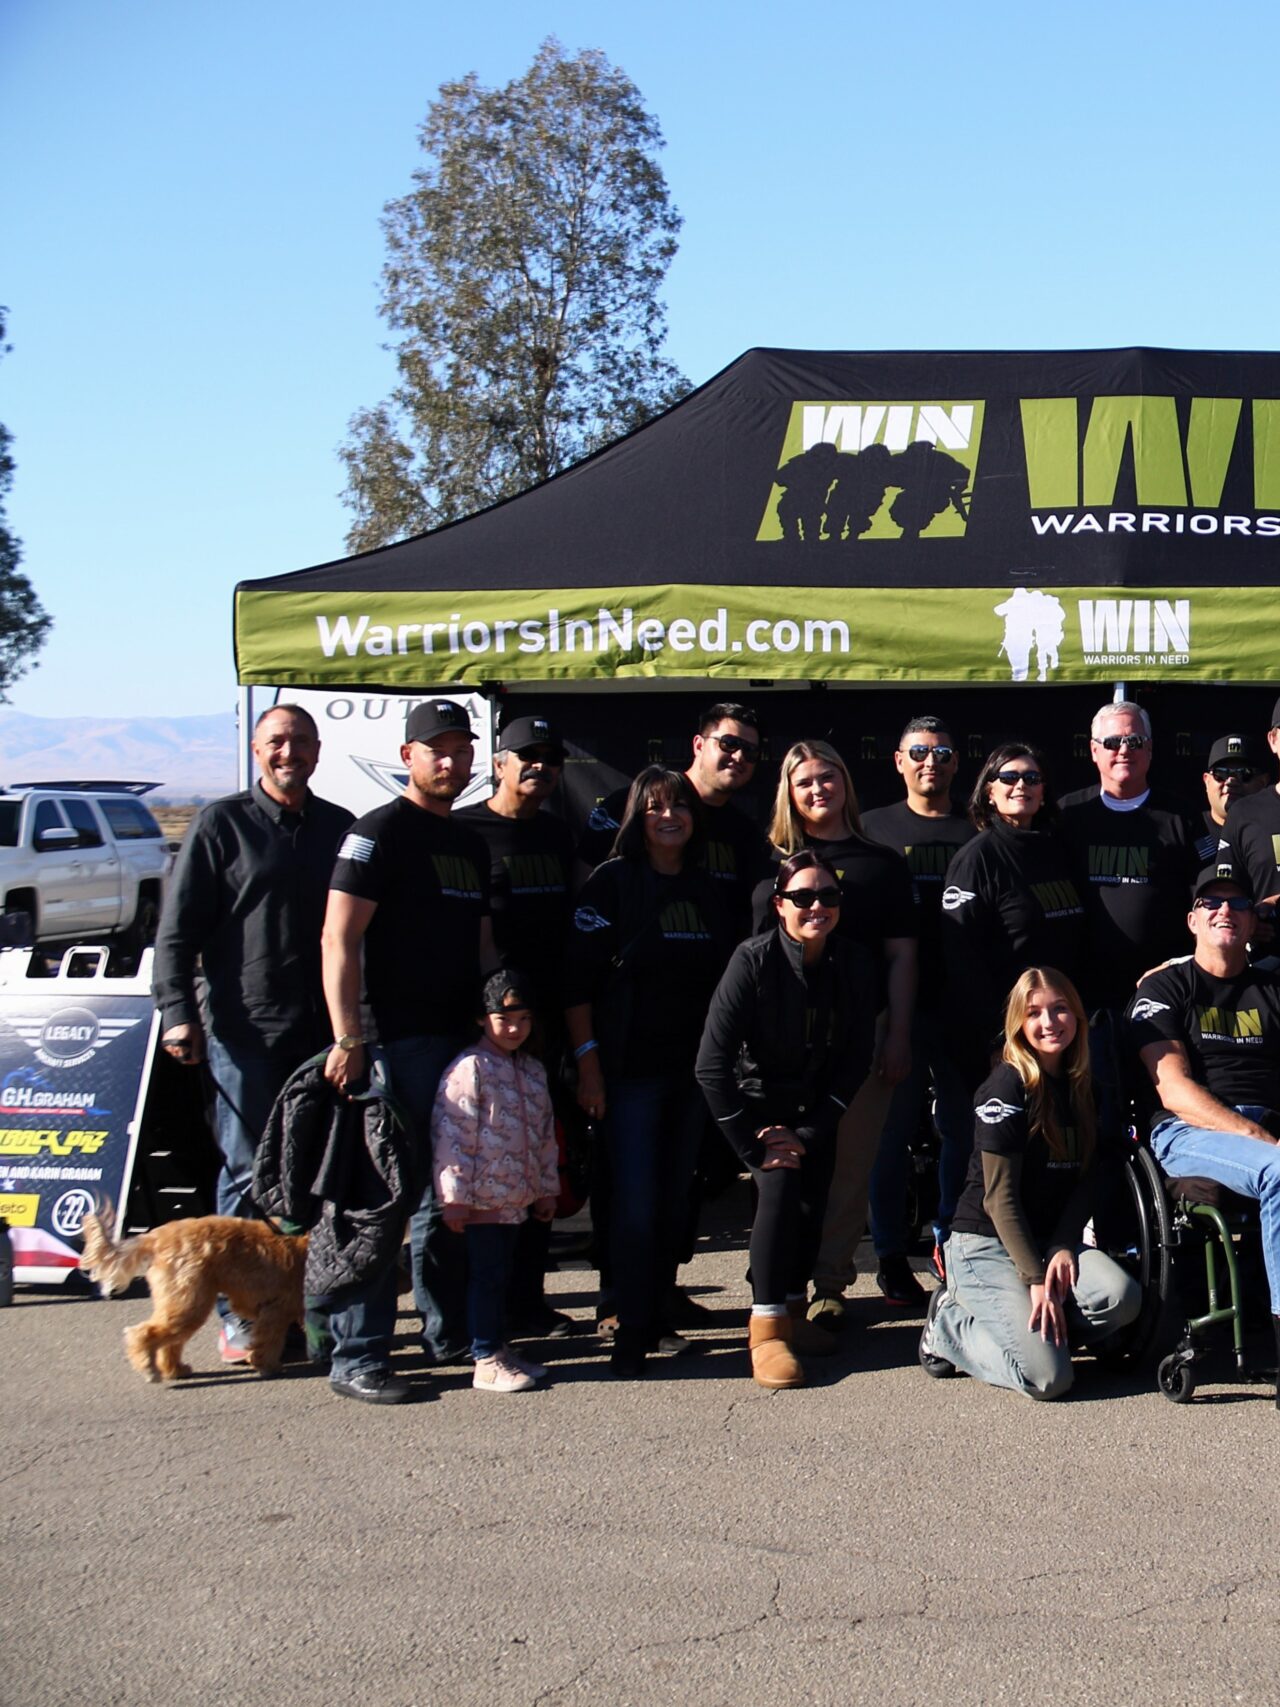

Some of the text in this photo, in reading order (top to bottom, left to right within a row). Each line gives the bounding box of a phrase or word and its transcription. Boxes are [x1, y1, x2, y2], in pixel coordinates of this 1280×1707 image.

[803, 405, 973, 450] WIN
[315, 608, 851, 656] WarriorsInNeed.com
[1078, 599, 1190, 652] WIN
[1083, 655, 1189, 665] WARRIORS IN NEED
[1088, 845, 1149, 876] WIN
[45, 1026, 95, 1040] LEGACY
[10, 1166, 30, 1179] AND
[60, 1167, 102, 1180] GRAHAM
[61, 1195, 85, 1229] 22
